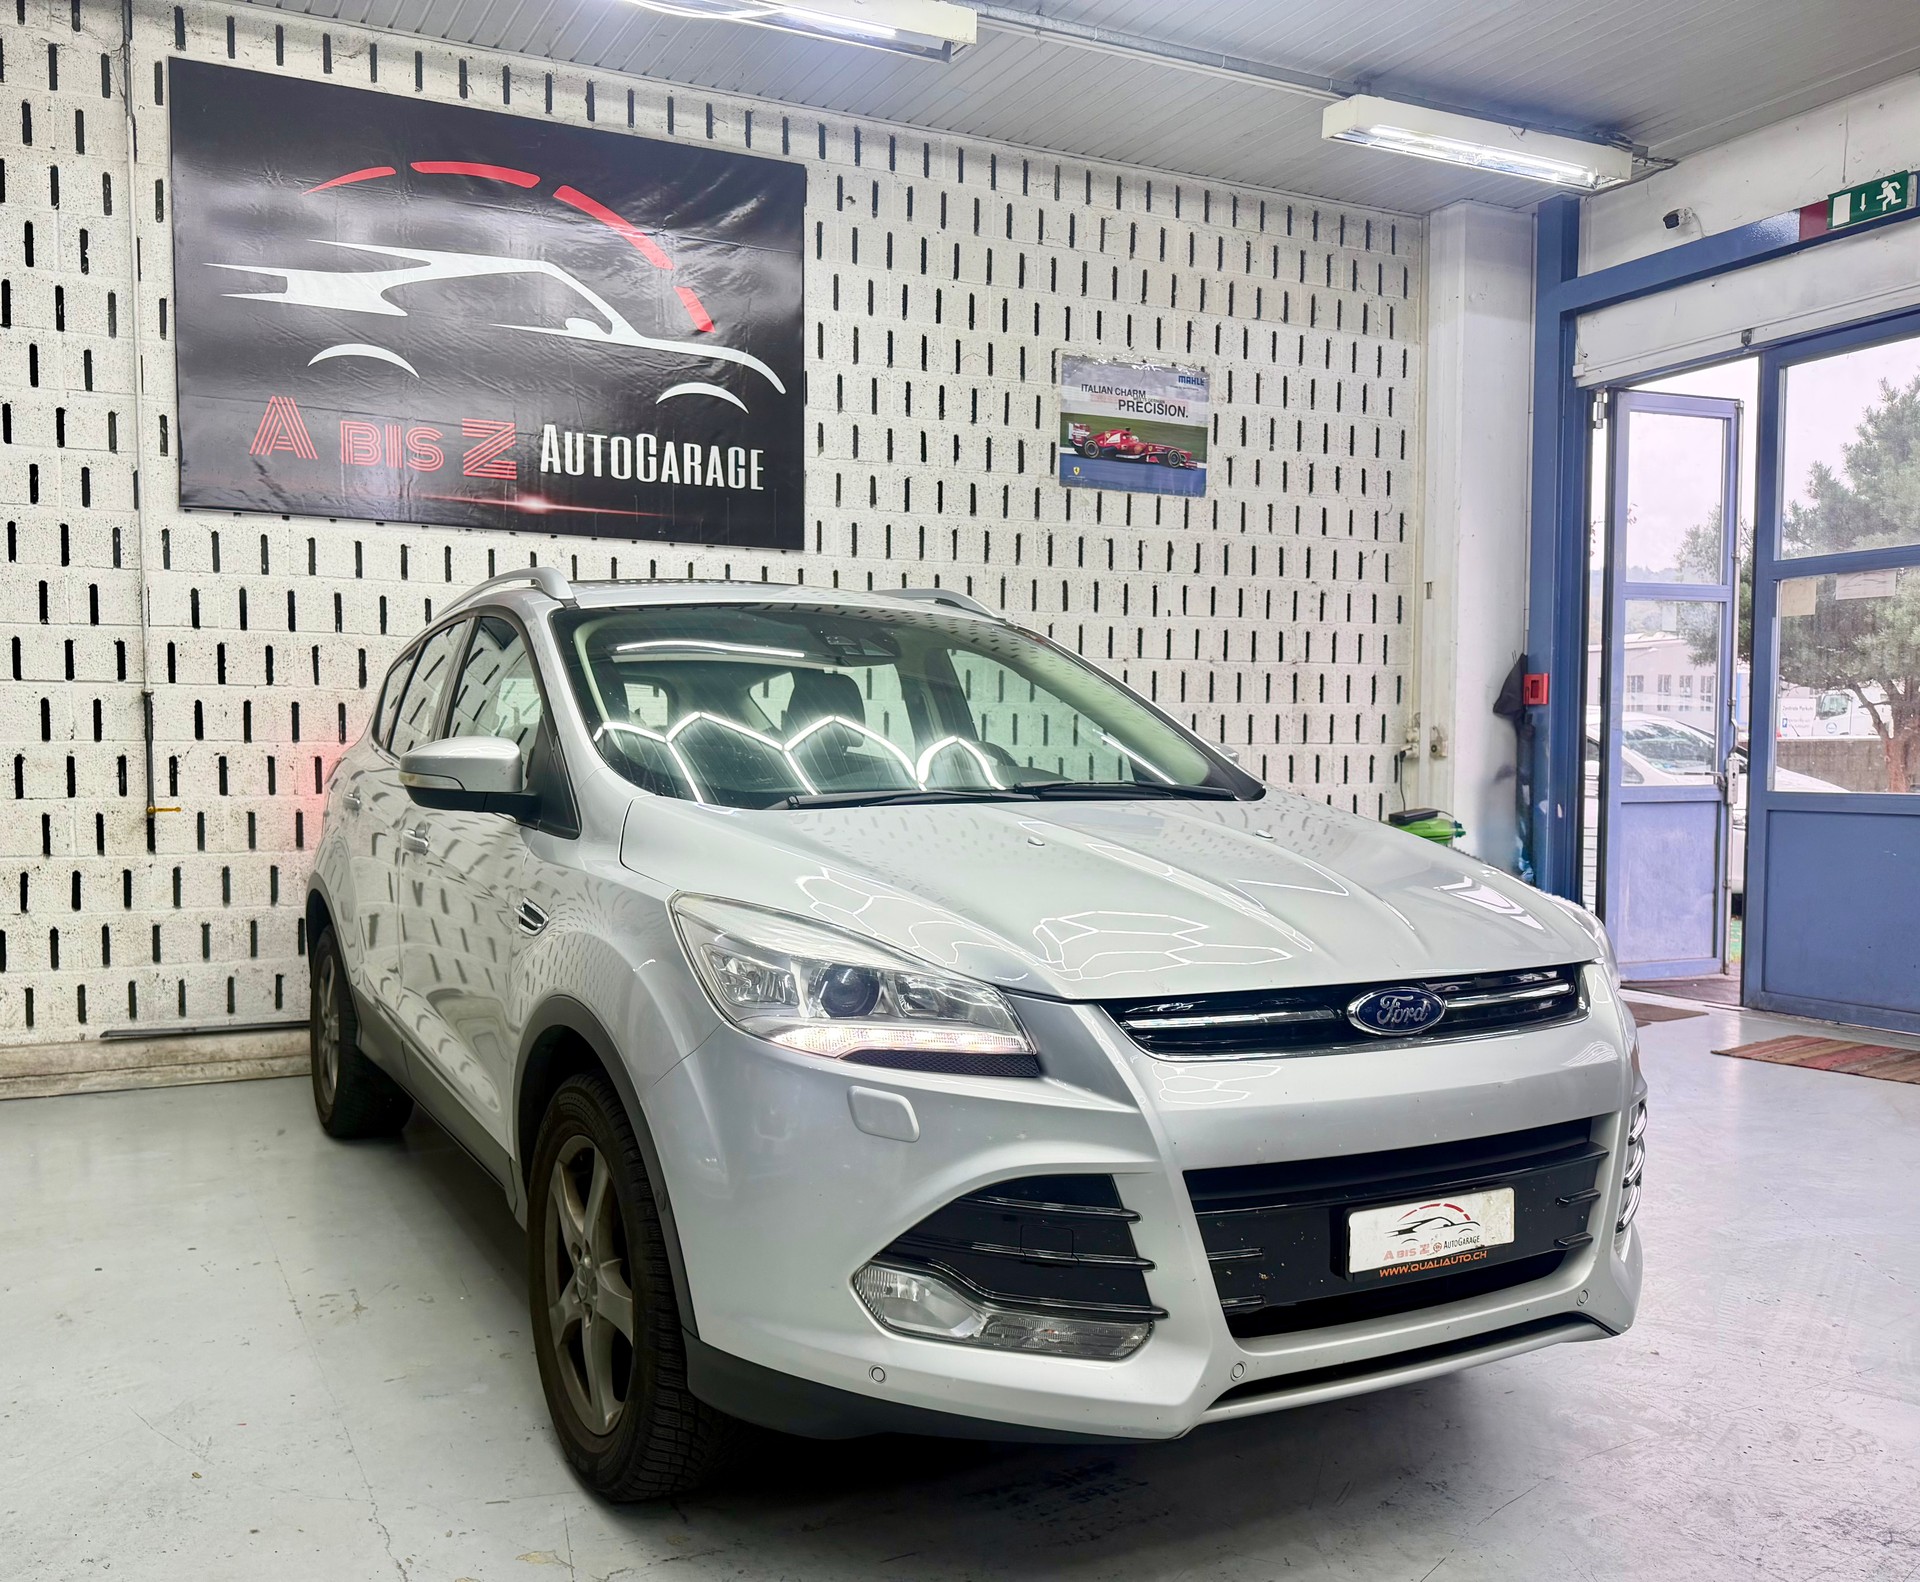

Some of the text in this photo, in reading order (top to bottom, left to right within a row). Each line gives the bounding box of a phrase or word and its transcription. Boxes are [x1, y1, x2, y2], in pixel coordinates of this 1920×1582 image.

[1178, 375, 1204, 386] MAHLE
[1081, 383, 1146, 399] ITALIAN CHARM
[1118, 399, 1189, 418] PRECISION.
[249, 396, 318, 460] A
[340, 420, 444, 472] BIS
[461, 417, 517, 480] Z
[1376, 995, 1431, 1025] Ford
[1379, 1250, 1488, 1277] WWW.QUALIAUTO.CH
[1384, 1250, 1394, 1260] A
[1396, 1248, 1417, 1258] BIS
